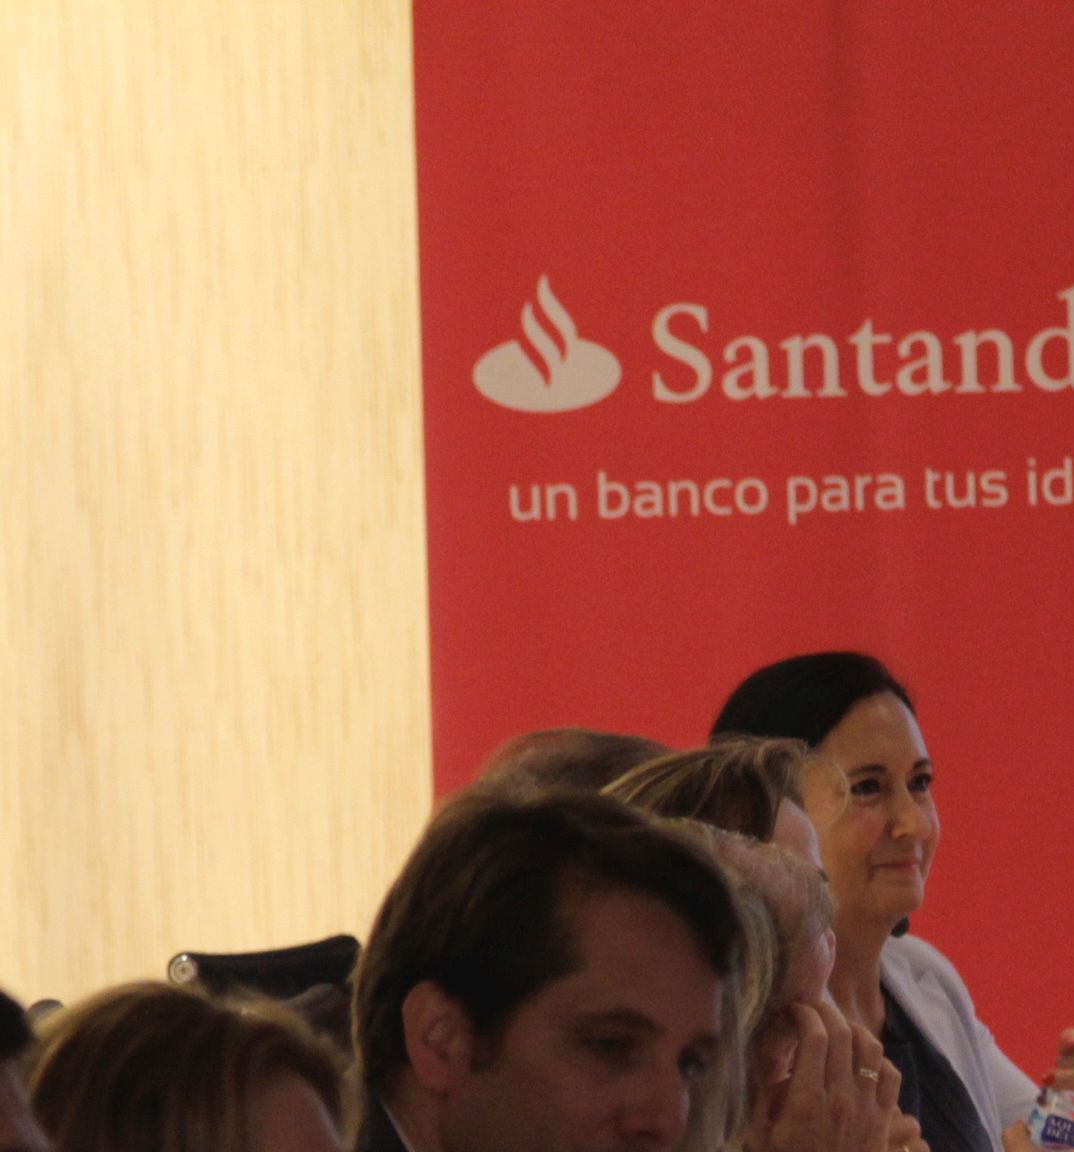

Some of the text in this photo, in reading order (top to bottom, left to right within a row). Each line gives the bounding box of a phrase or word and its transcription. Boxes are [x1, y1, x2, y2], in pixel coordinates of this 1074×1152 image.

[509, 483, 578, 522] un
[597, 471, 769, 519] banco
[787, 472, 906, 525] para
[925, 467, 1009, 509] tus
